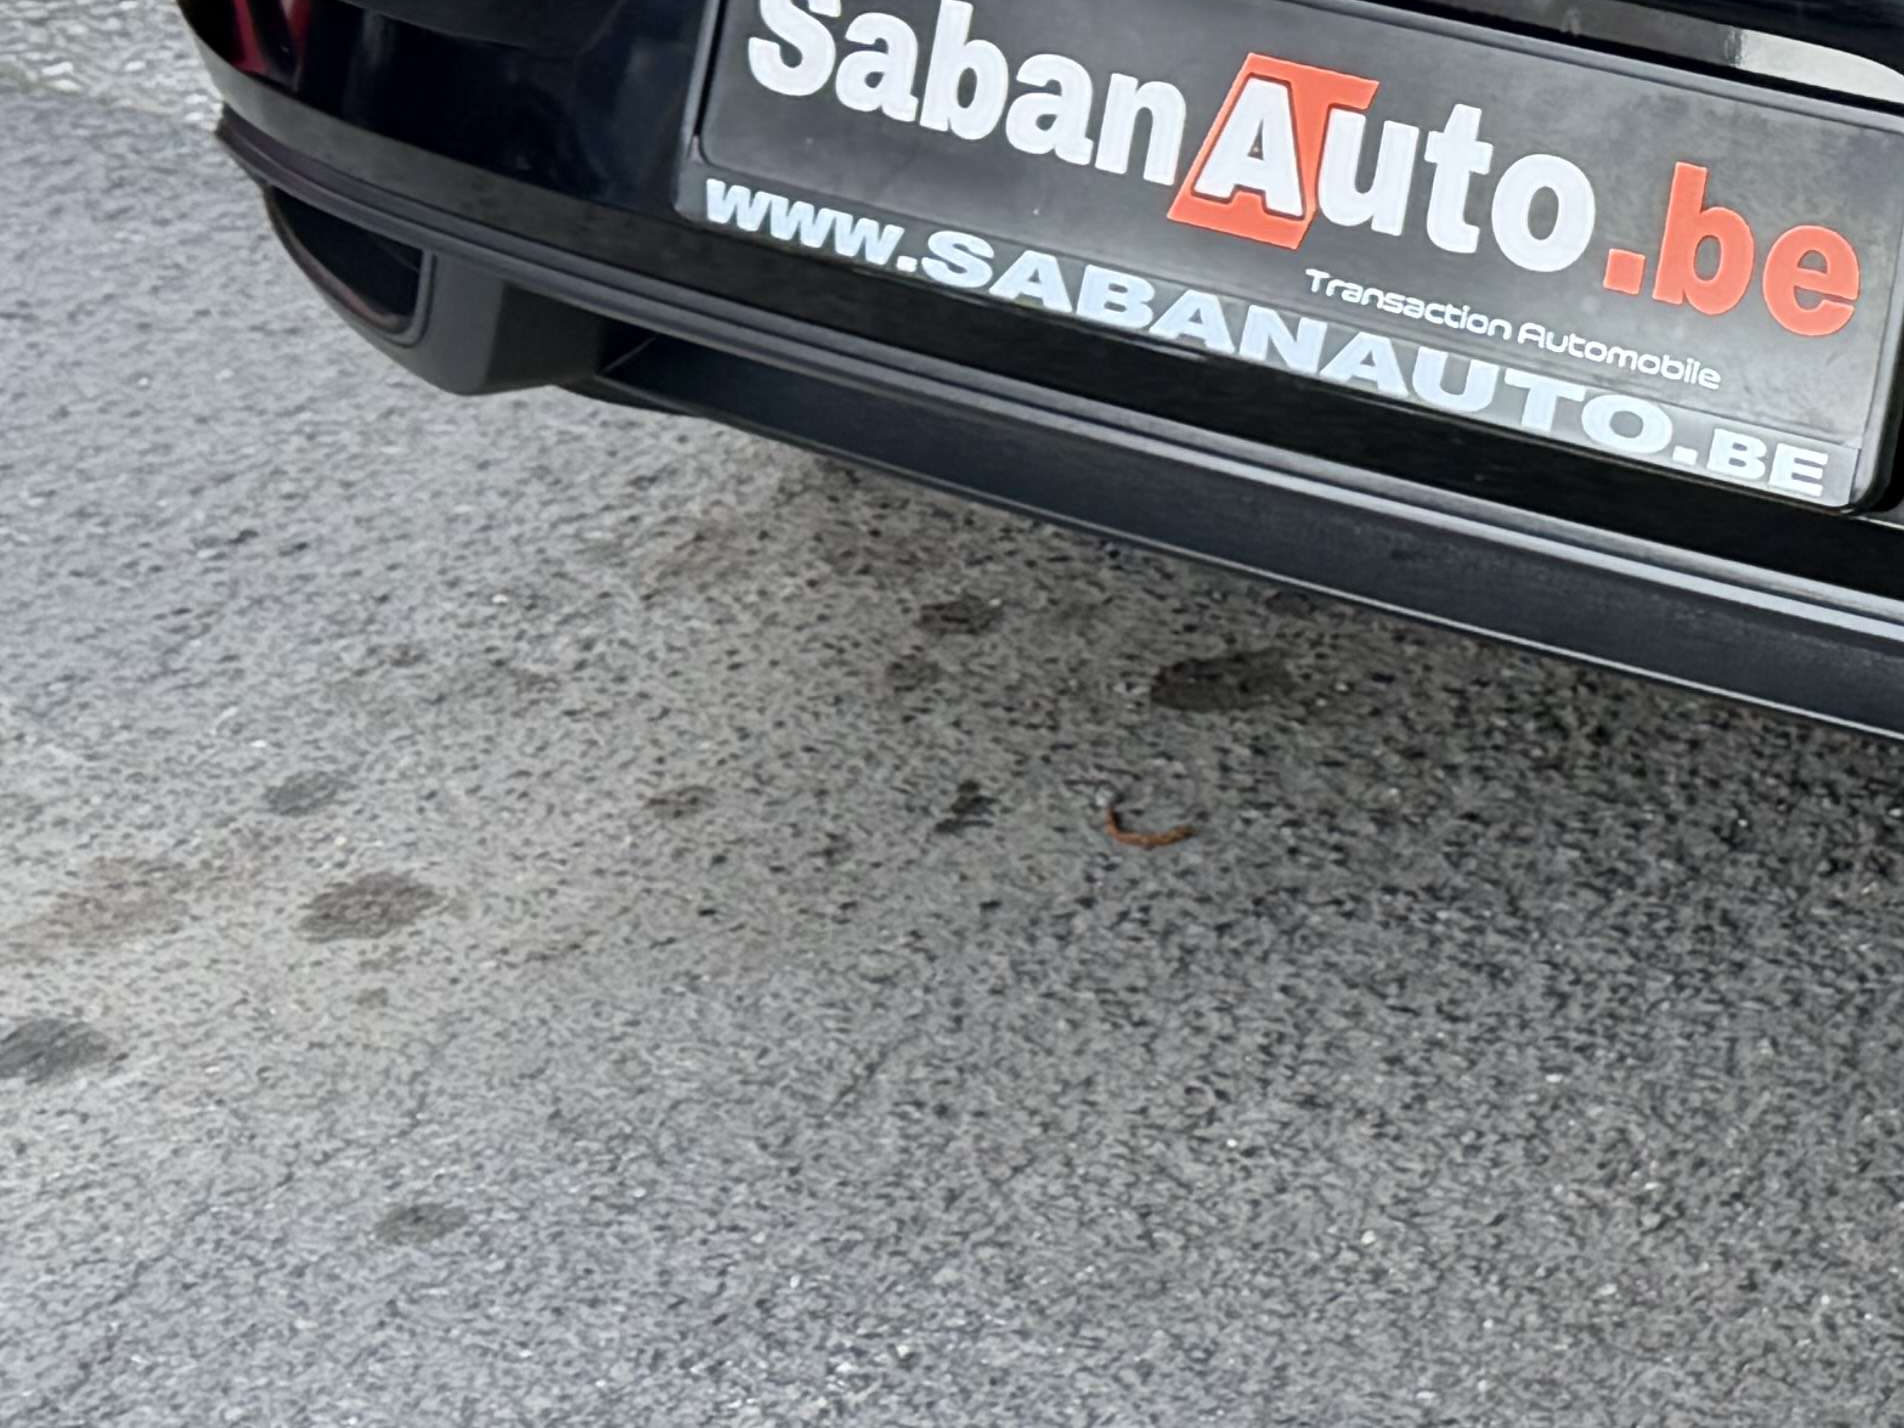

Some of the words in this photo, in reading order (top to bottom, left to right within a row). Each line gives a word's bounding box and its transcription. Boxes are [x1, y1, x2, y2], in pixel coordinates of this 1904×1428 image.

[703, 179, 1829, 499] www.SABANAUTO.BE
[1304, 268, 1513, 341] Transaction
[1516, 318, 1724, 392] Automobile
